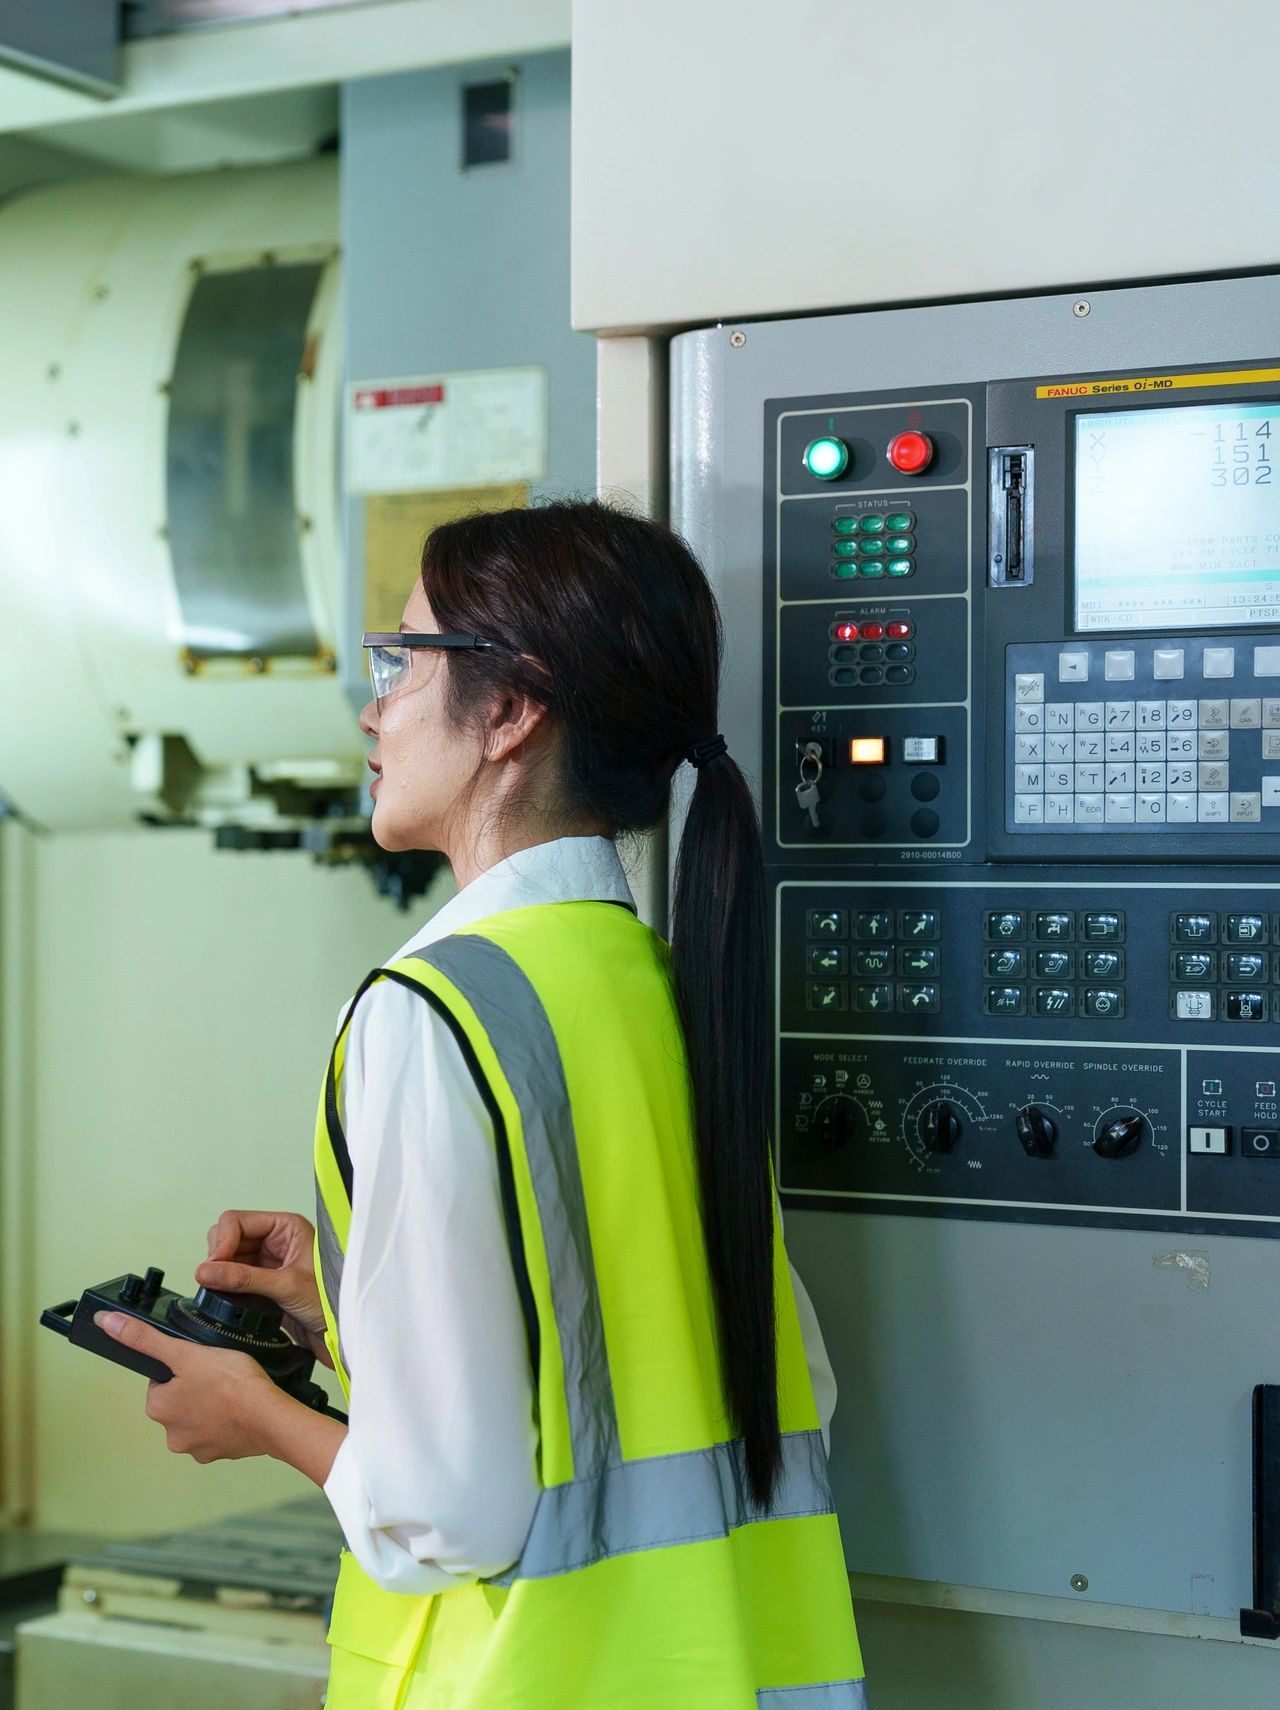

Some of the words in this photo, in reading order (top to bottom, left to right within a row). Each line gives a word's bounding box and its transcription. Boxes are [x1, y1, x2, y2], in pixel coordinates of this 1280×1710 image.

[1048, 387, 1088, 397] FANUC
[1092, 384, 1129, 394] Series
[1090, 432, 1106, 449] X
[1091, 454, 1105, 472] Y
[1213, 443, 1270, 465] 151
[1089, 476, 1104, 495] Z
[1211, 466, 1273, 487] 302
[857, 500, 889, 509] STATUS
[1222, 535, 1258, 544] PARTS
[1222, 545, 1258, 556] CYCLE
[1265, 582, 1273, 591] S
[860, 607, 886, 615] ALARM
[1058, 713, 1068, 725] N
[1088, 713, 1099, 724] G
[1120, 710, 1130, 722] 7
[1151, 710, 1161, 721] 8
[1182, 709, 1192, 721] 9
[1029, 744, 1038, 756] X
[1059, 743, 1068, 755] Y
[1089, 743, 1098, 754] Z
[1120, 741, 1130, 752] 4
[1151, 740, 1161, 752] 5
[1182, 740, 1192, 752] 6
[1028, 774, 1039, 786] M
[1058, 774, 1068, 786] S
[1088, 773, 1099, 785] T
[1120, 771, 1126, 783] 1
[1151, 771, 1161, 783] 2
[1182, 770, 1192, 783] 3
[1028, 804, 1038, 816] F
[1058, 804, 1068, 816] H
[900, 851, 962, 859] 2910-00014B00
[814, 1054, 835, 1062] MODE
[838, 1054, 869, 1062] SELECT
[903, 1056, 944, 1065] FEEDRATE
[947, 1058, 987, 1067] OVERRIDE
[1005, 1059, 1031, 1068] RAPID
[1034, 1061, 1075, 1070] OVERRIDE
[1083, 1063, 1118, 1071] SPINDLE
[1122, 1064, 1164, 1073] OVERRIDE
[1197, 1100, 1228, 1108] CYCLE
[1254, 1102, 1277, 1110] FEED
[1198, 1109, 1226, 1117] START
[1254, 1112, 1278, 1120] HOLD
